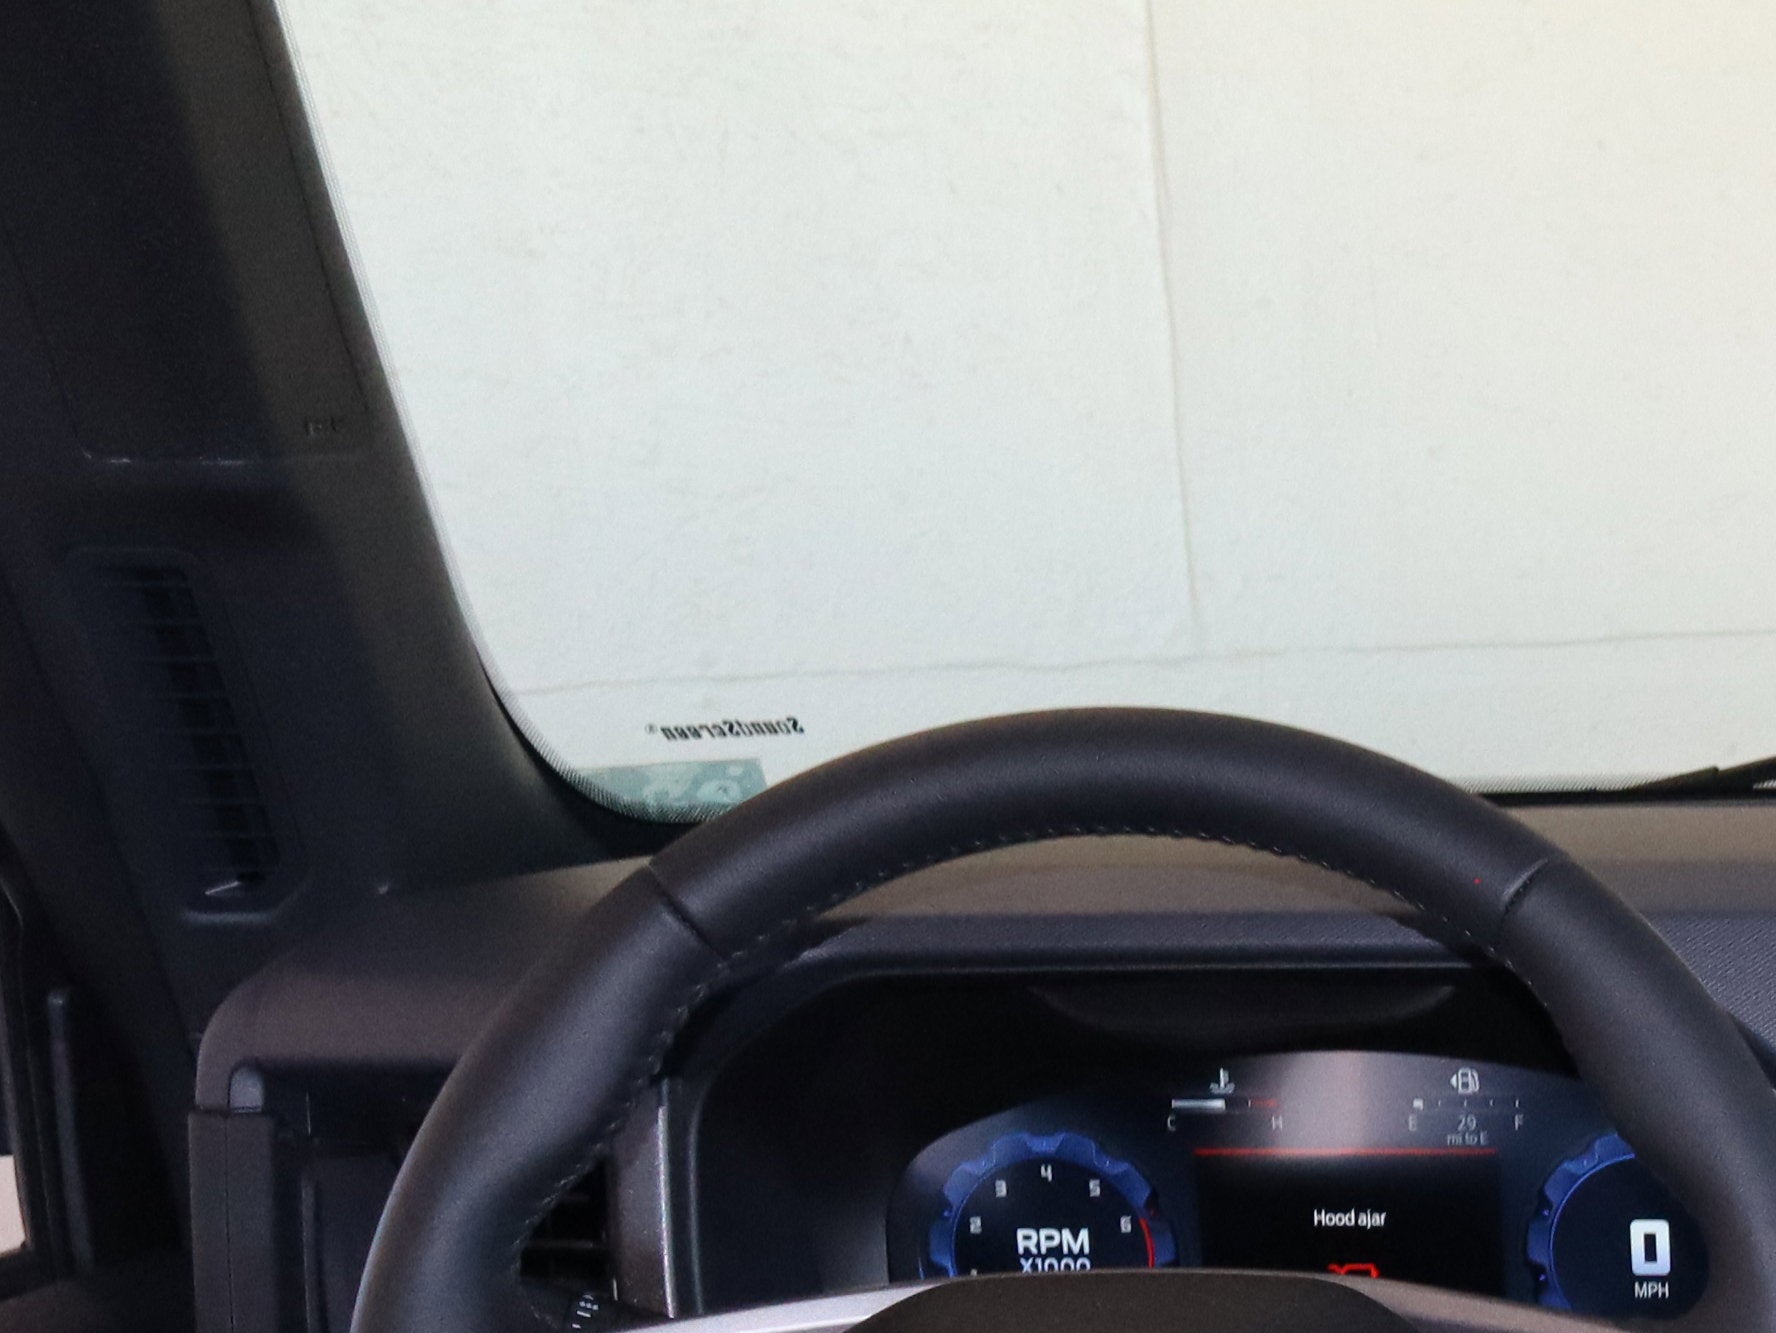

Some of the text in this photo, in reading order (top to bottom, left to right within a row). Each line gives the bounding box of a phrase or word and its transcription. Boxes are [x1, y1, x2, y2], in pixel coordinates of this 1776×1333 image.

[1167, 1115, 1176, 1131] C
[1272, 1115, 1283, 1130] H
[1457, 1115, 1477, 1130] 29
[1040, 1164, 1052, 1182] 4
[969, 1216, 982, 1234] 2
[1120, 1216, 1132, 1233] 6
[1313, 1208, 1386, 1230] Hood ajar
[1017, 1228, 1090, 1255] RPM
[1634, 1281, 1669, 1299] MPH
